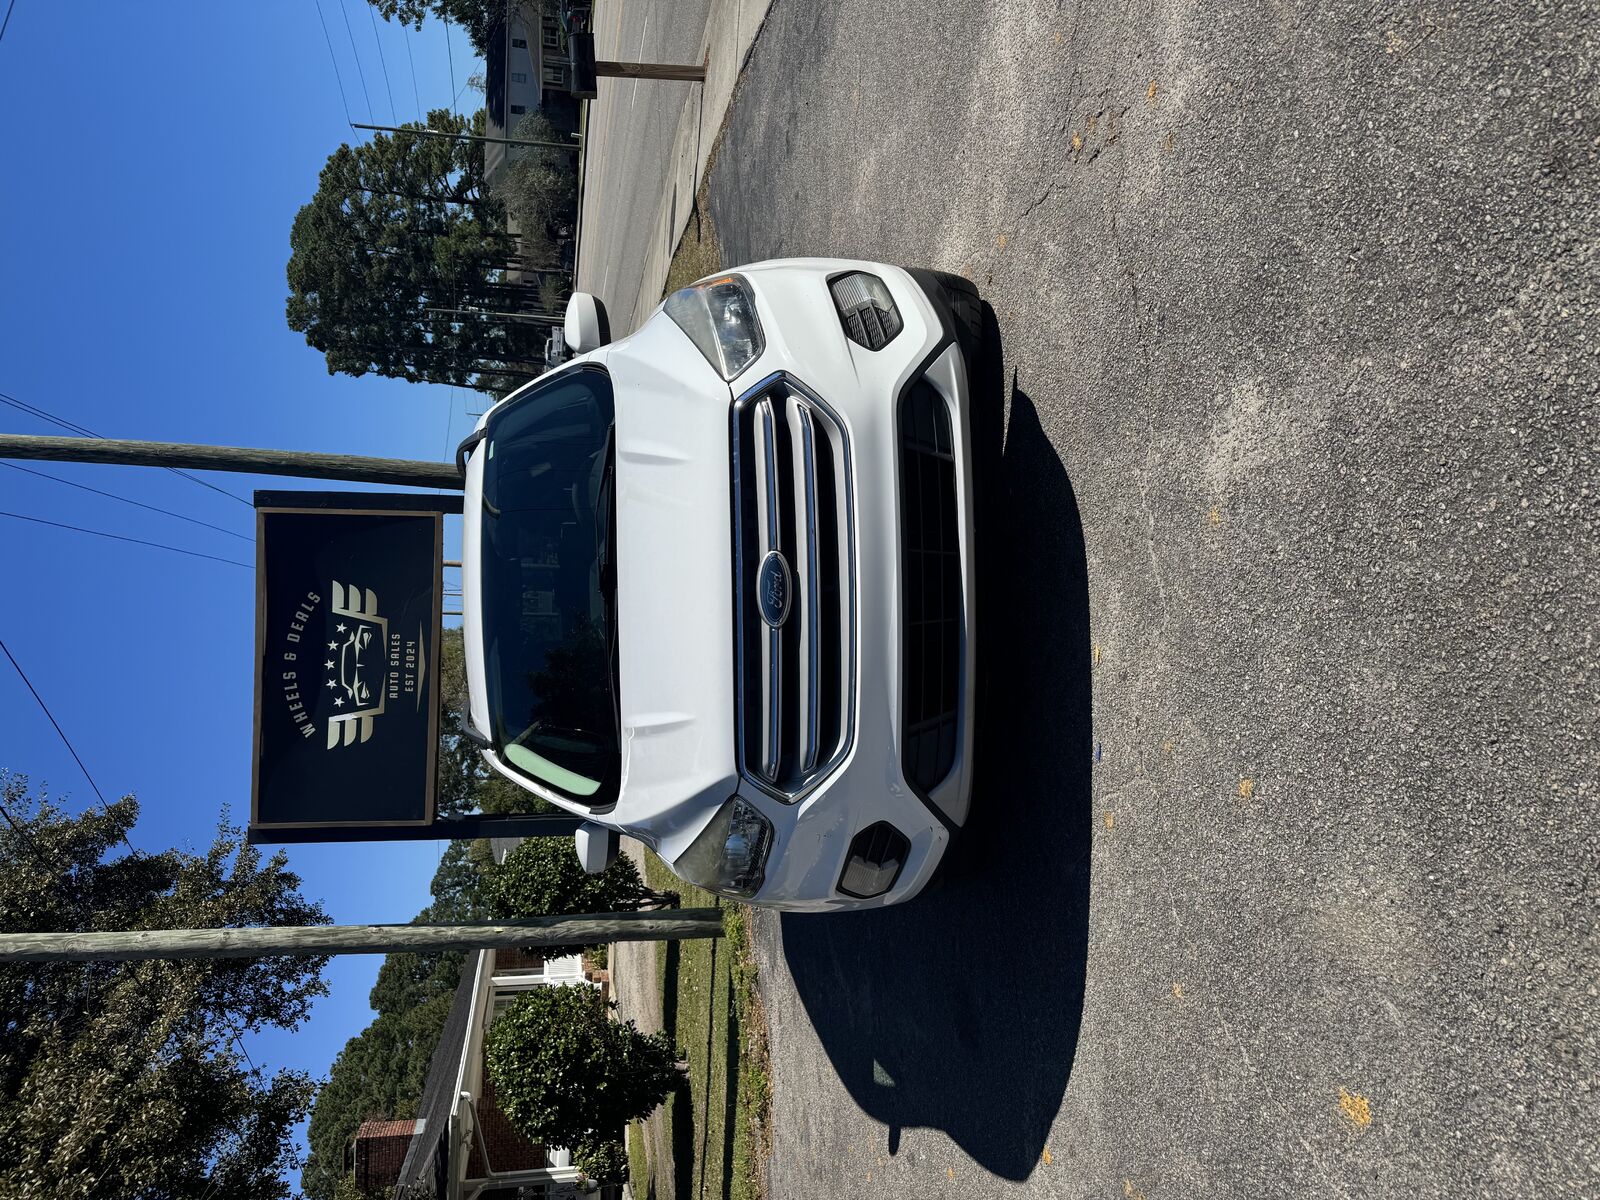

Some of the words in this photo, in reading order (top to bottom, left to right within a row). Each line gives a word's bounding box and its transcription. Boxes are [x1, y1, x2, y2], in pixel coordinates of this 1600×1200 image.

[766, 571, 782, 608] Ford
[287, 591, 321, 643] DEALS
[284, 652, 297, 661] &
[391, 633, 401, 667] SALES
[405, 641, 415, 669] 2024
[389, 672, 399, 699] AUTO
[404, 673, 414, 692] EST
[282, 671, 316, 738] WHEELS
